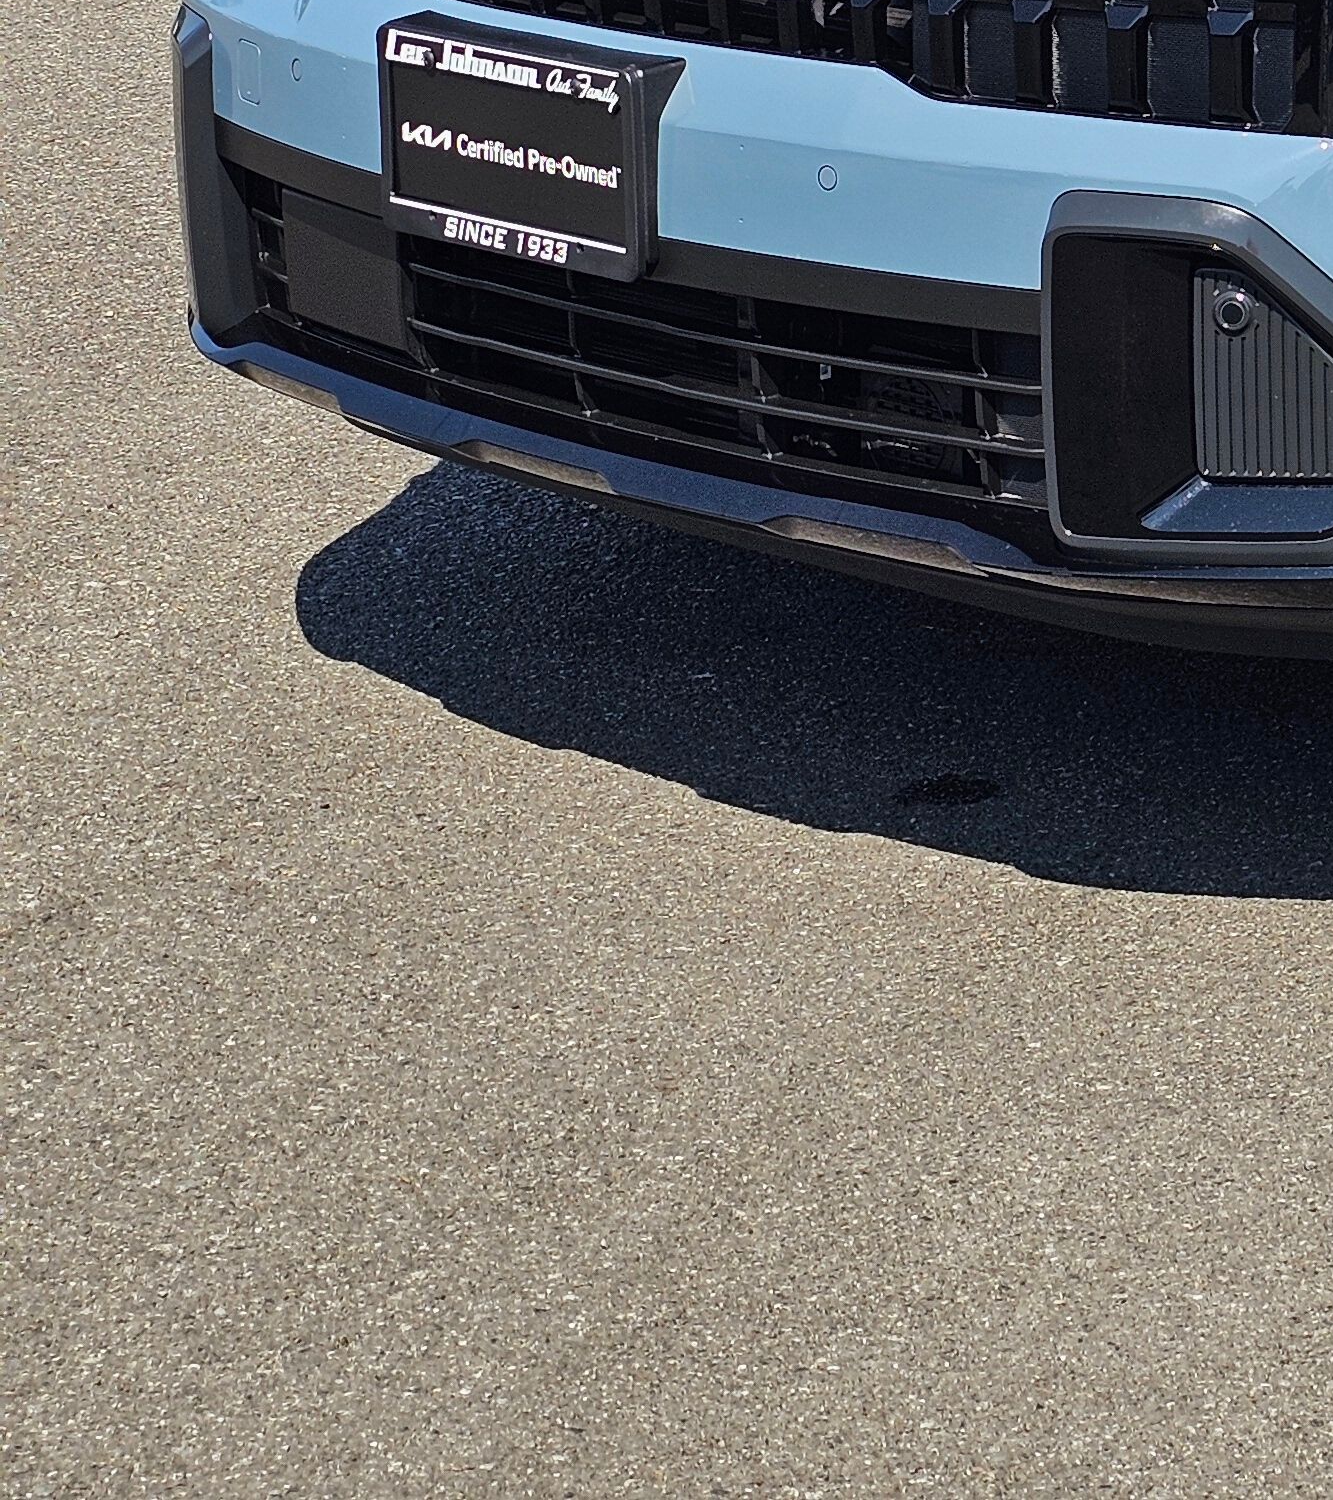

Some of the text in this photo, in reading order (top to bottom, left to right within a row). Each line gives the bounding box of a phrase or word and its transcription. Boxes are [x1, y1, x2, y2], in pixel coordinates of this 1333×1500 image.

[435, 40, 542, 88] Johnson
[401, 121, 452, 150] KIA
[456, 133, 524, 169] Certified
[444, 216, 568, 264] SINCE 1933
